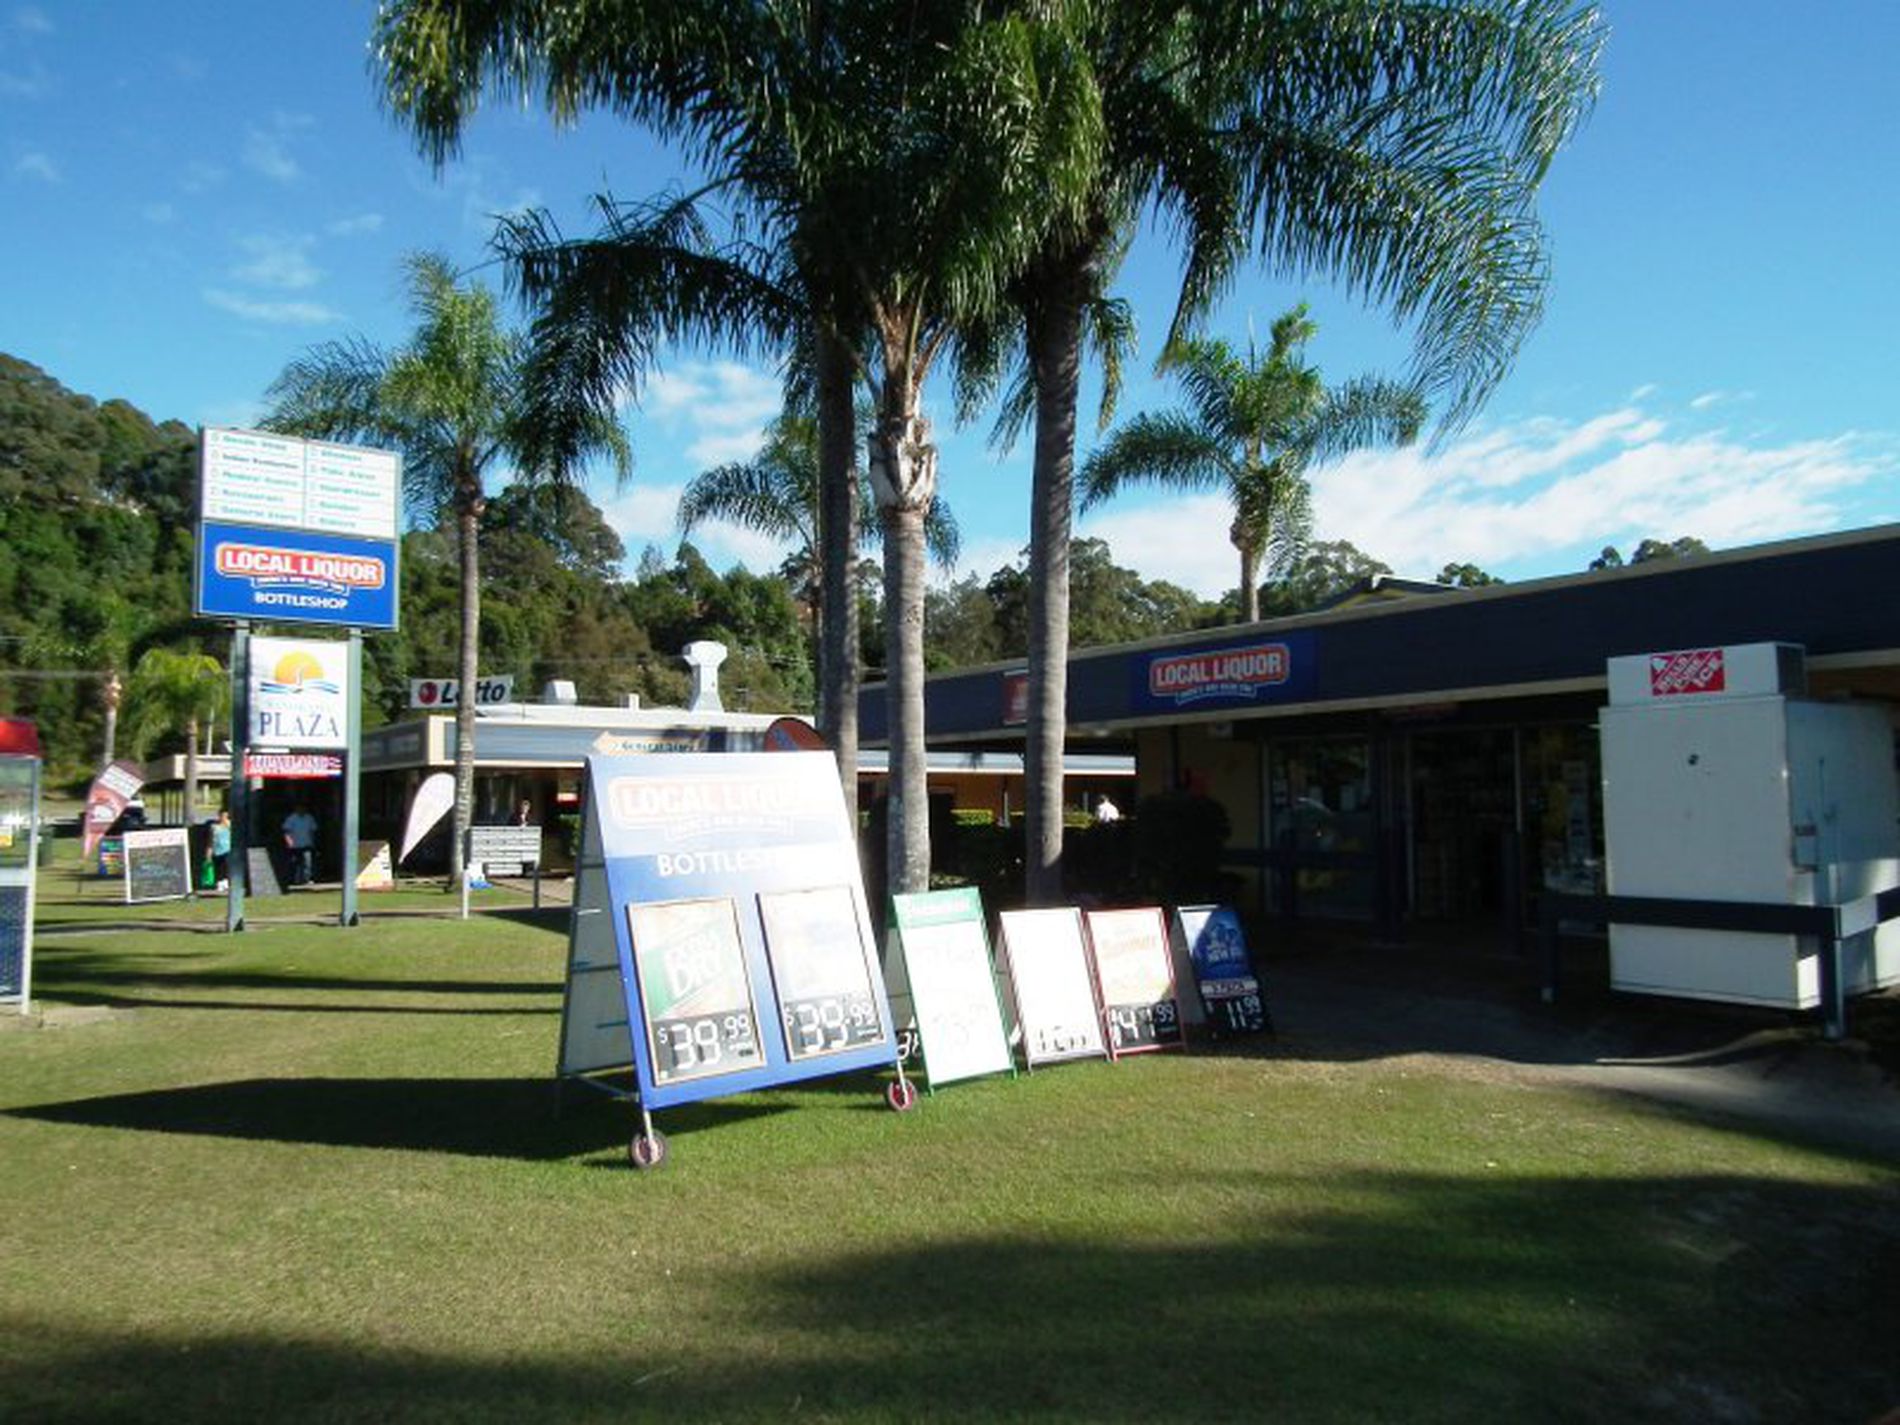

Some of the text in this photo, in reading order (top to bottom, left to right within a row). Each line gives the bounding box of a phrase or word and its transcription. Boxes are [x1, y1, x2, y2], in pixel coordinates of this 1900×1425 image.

[225, 551, 378, 581] LOCAL LIQUOR
[254, 591, 348, 609] BOTTLESHOP
[1156, 653, 1282, 687] LOCAL LIQUOR
[441, 681, 505, 702] Ltto
[260, 711, 339, 737] PLAZA
[621, 783, 716, 814] LOCAL
